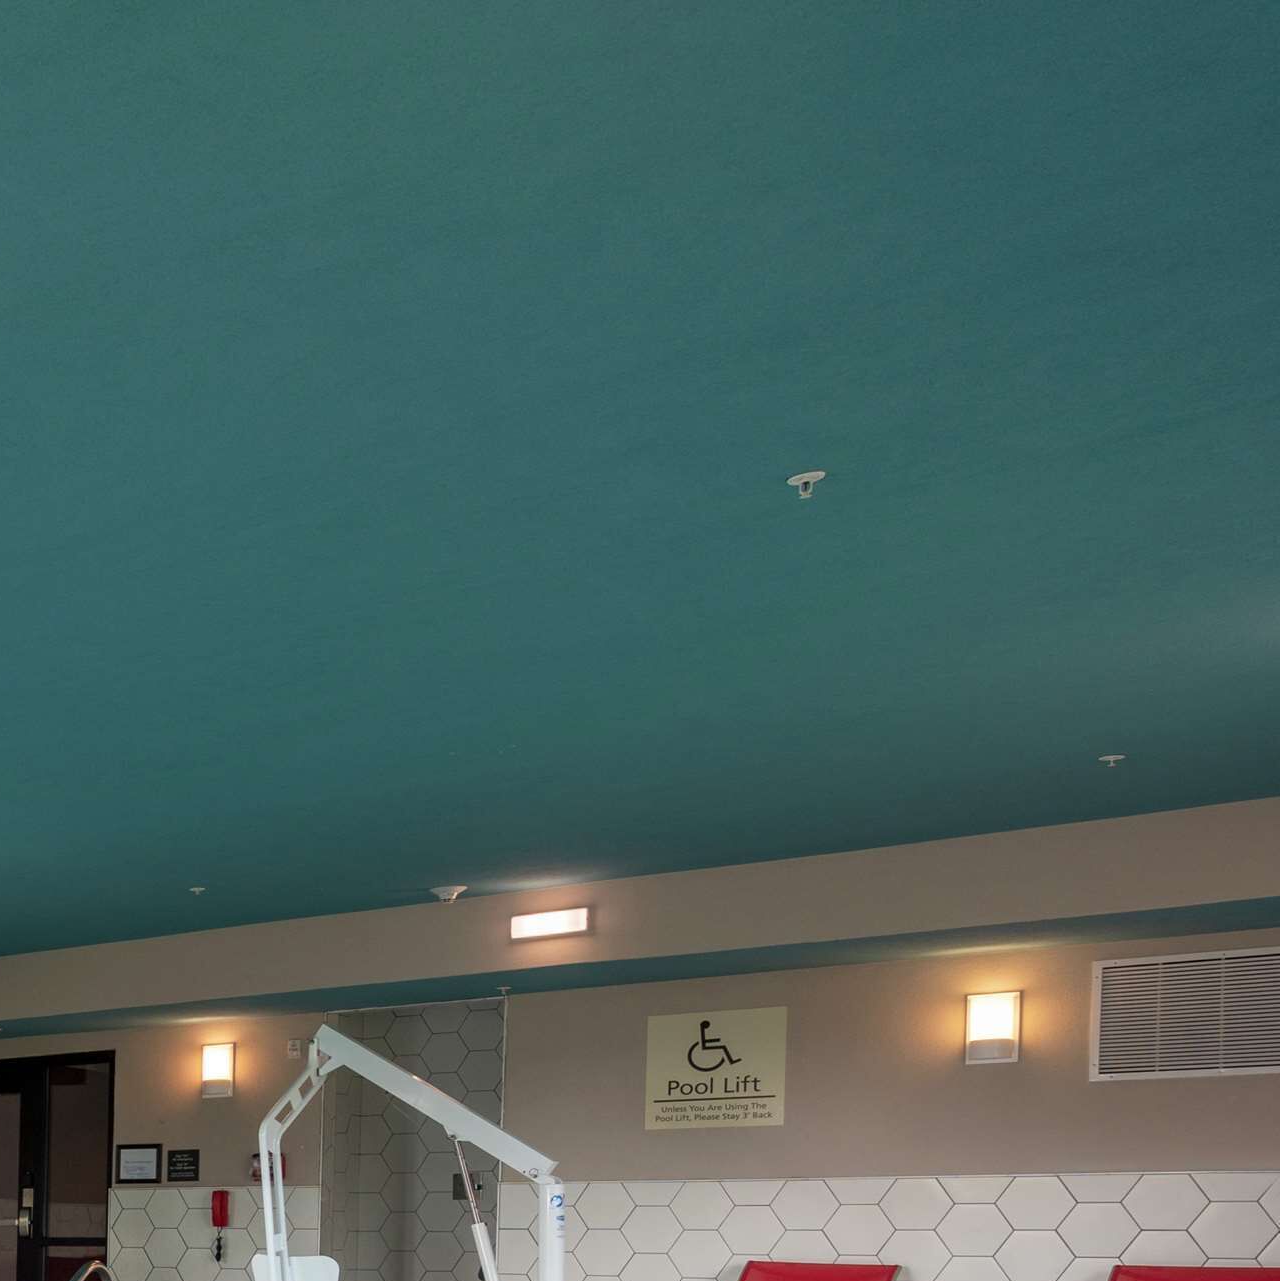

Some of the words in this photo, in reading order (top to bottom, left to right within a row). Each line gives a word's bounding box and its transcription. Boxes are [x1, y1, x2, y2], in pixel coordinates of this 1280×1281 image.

[668, 1077, 714, 1096] Pool
[724, 1075, 761, 1094] Lift
[689, 1104, 705, 1112] You
[724, 1103, 748, 1112] Using
[751, 1102, 767, 1110] The
[694, 1113, 720, 1121] Please
[722, 1112, 741, 1121] Stay
